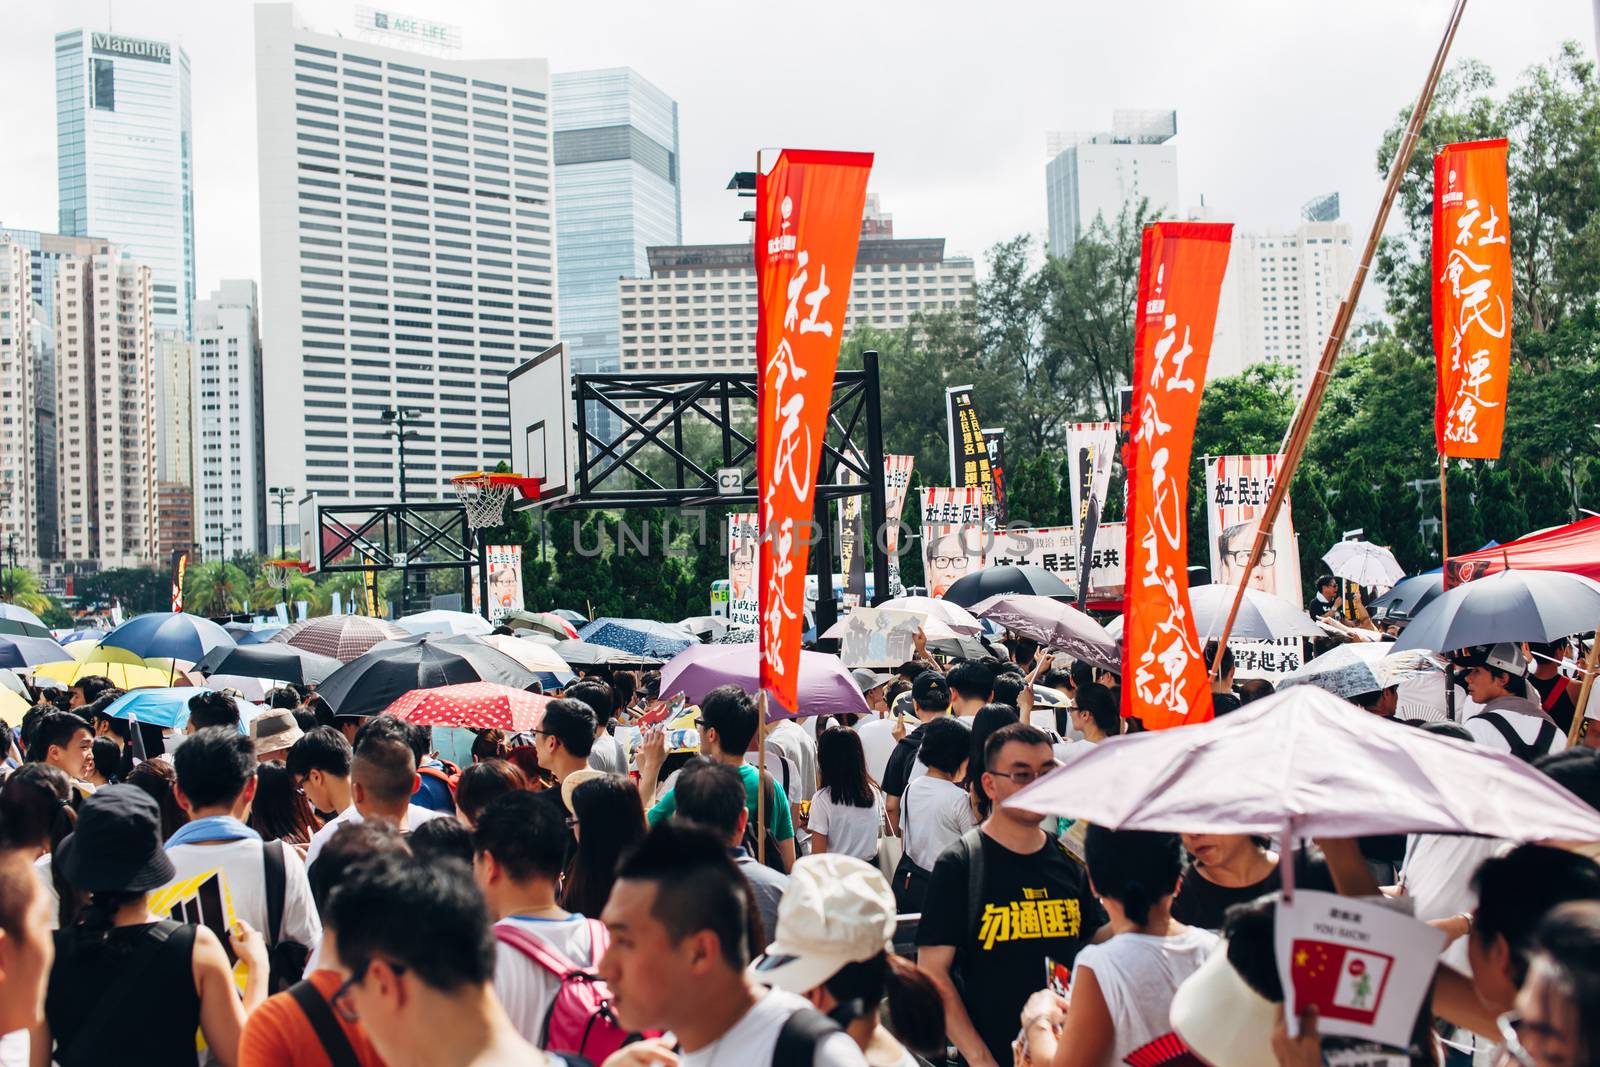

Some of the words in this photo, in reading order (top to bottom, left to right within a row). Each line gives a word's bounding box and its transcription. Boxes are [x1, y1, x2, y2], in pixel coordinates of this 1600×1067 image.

[422, 24, 447, 40] LIFE
[92, 32, 171, 60] Manulife
[719, 474, 741, 489] C2
